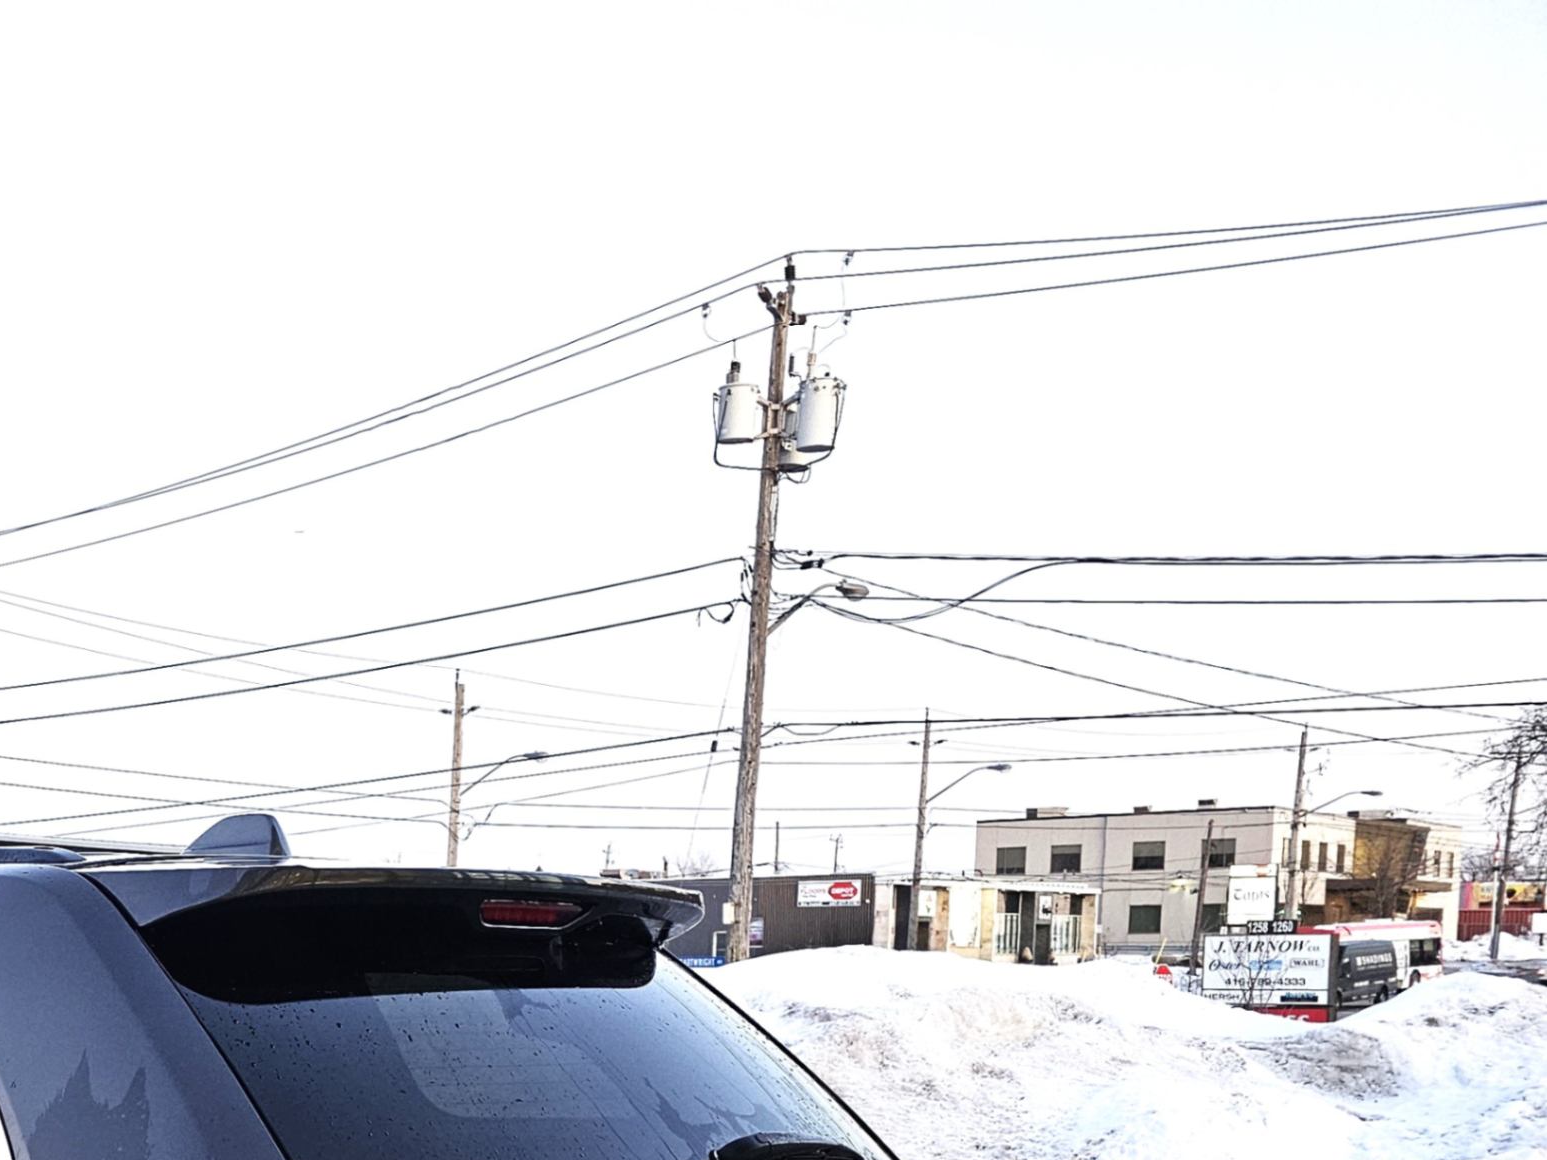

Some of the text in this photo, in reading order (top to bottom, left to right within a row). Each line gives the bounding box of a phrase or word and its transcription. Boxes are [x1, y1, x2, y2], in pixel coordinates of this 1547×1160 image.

[1248, 920, 1294, 933] 1258 1260
[1231, 939, 1306, 954] TARNOW
[1293, 959, 1320, 967] WAHL
